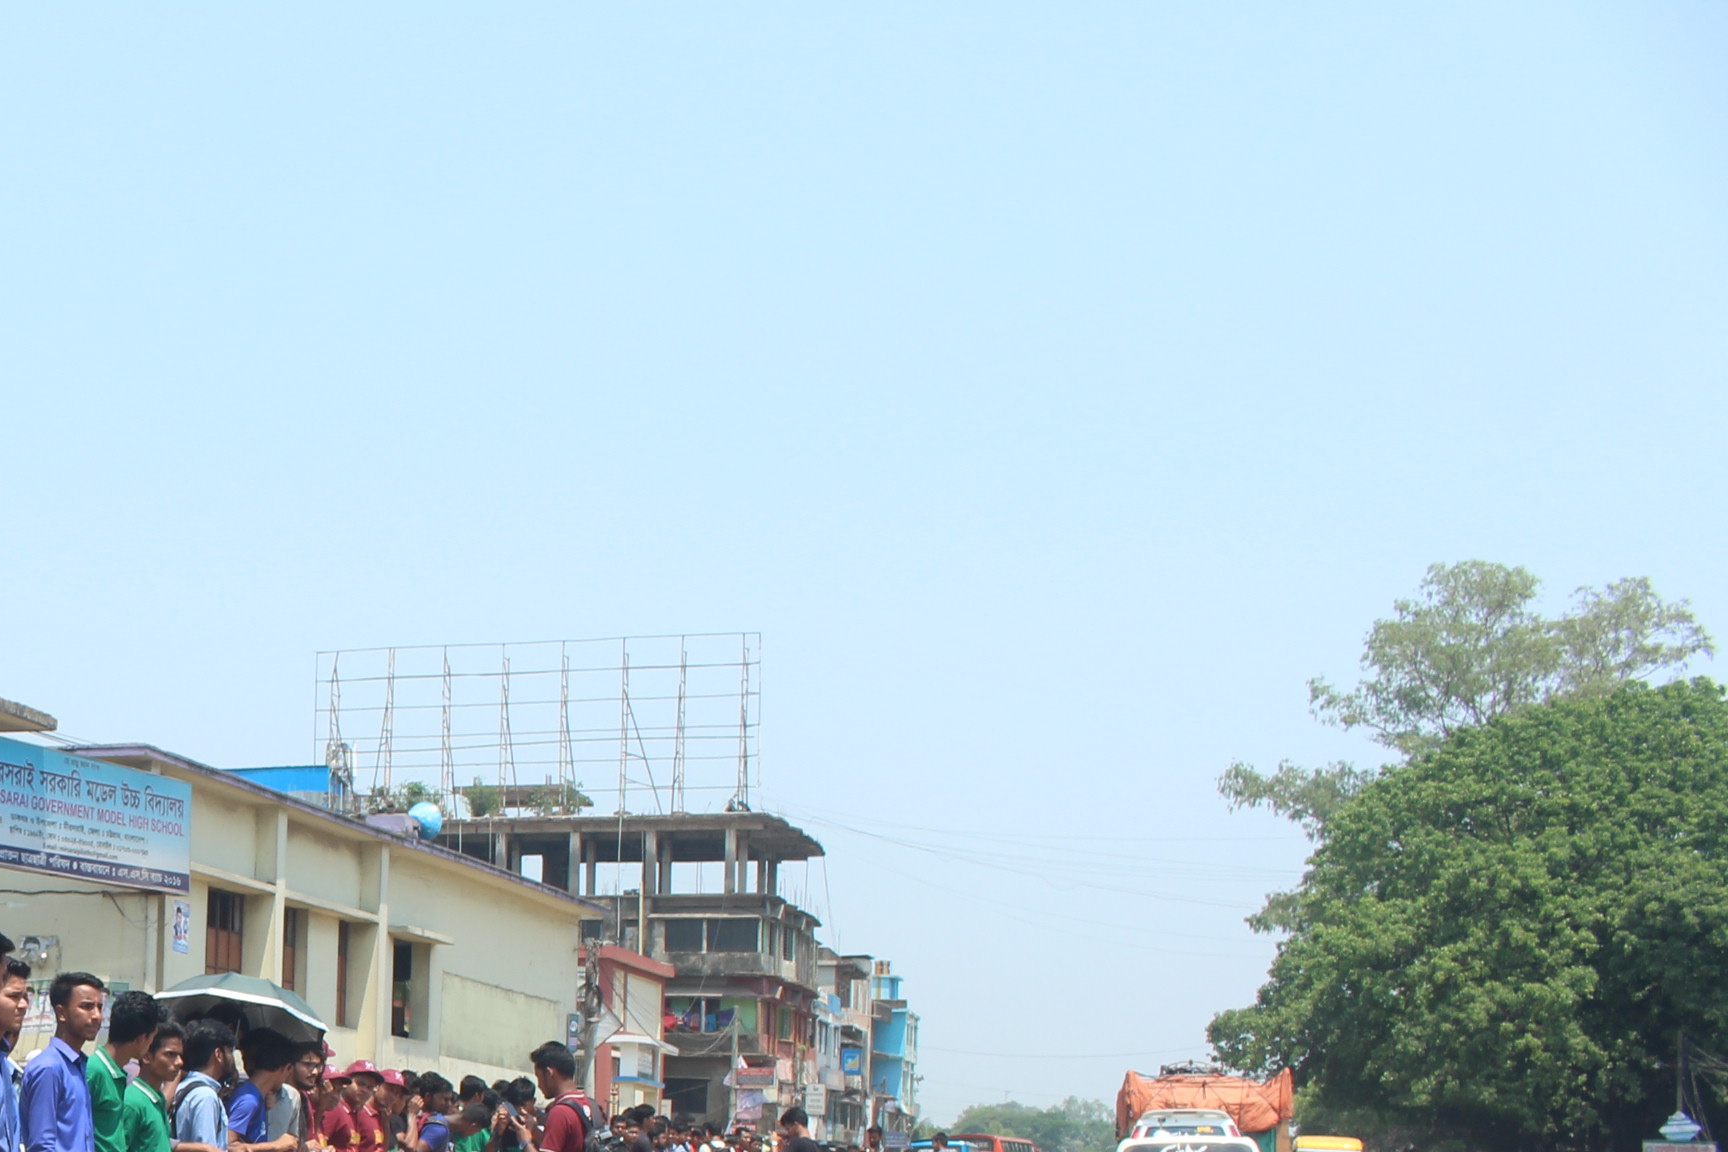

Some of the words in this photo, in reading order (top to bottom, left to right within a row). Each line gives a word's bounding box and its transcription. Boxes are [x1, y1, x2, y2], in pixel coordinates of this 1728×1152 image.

[31, 795, 95, 820] GOVERNMENT
[97, 808, 126, 826] MODEL
[129, 814, 149, 830] HIGH
[151, 818, 184, 837] SCHOOL
[39, 769, 82, 799] সরকারি
[86, 780, 117, 806] মডেল
[121, 780, 140, 809] উচ্চ
[145, 785, 184, 819] বিদ্যালয়
